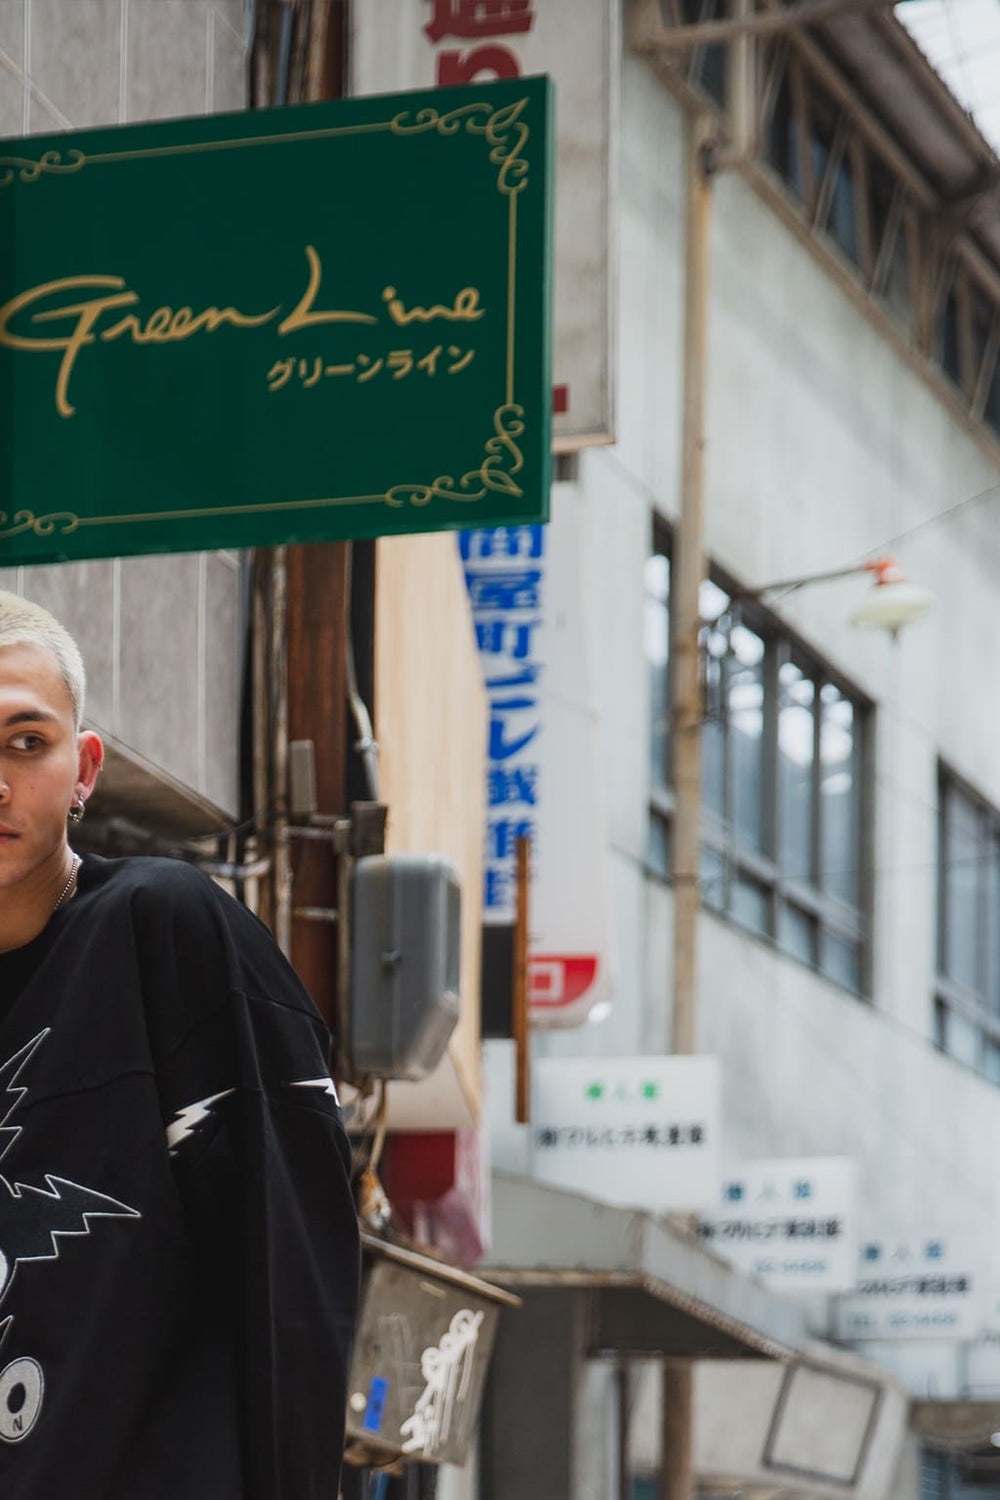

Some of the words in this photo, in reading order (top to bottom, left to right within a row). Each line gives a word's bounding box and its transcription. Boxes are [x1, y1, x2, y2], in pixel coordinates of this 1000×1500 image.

[278, 245, 487, 336] Line
[267, 345, 475, 391] グリーンライン
